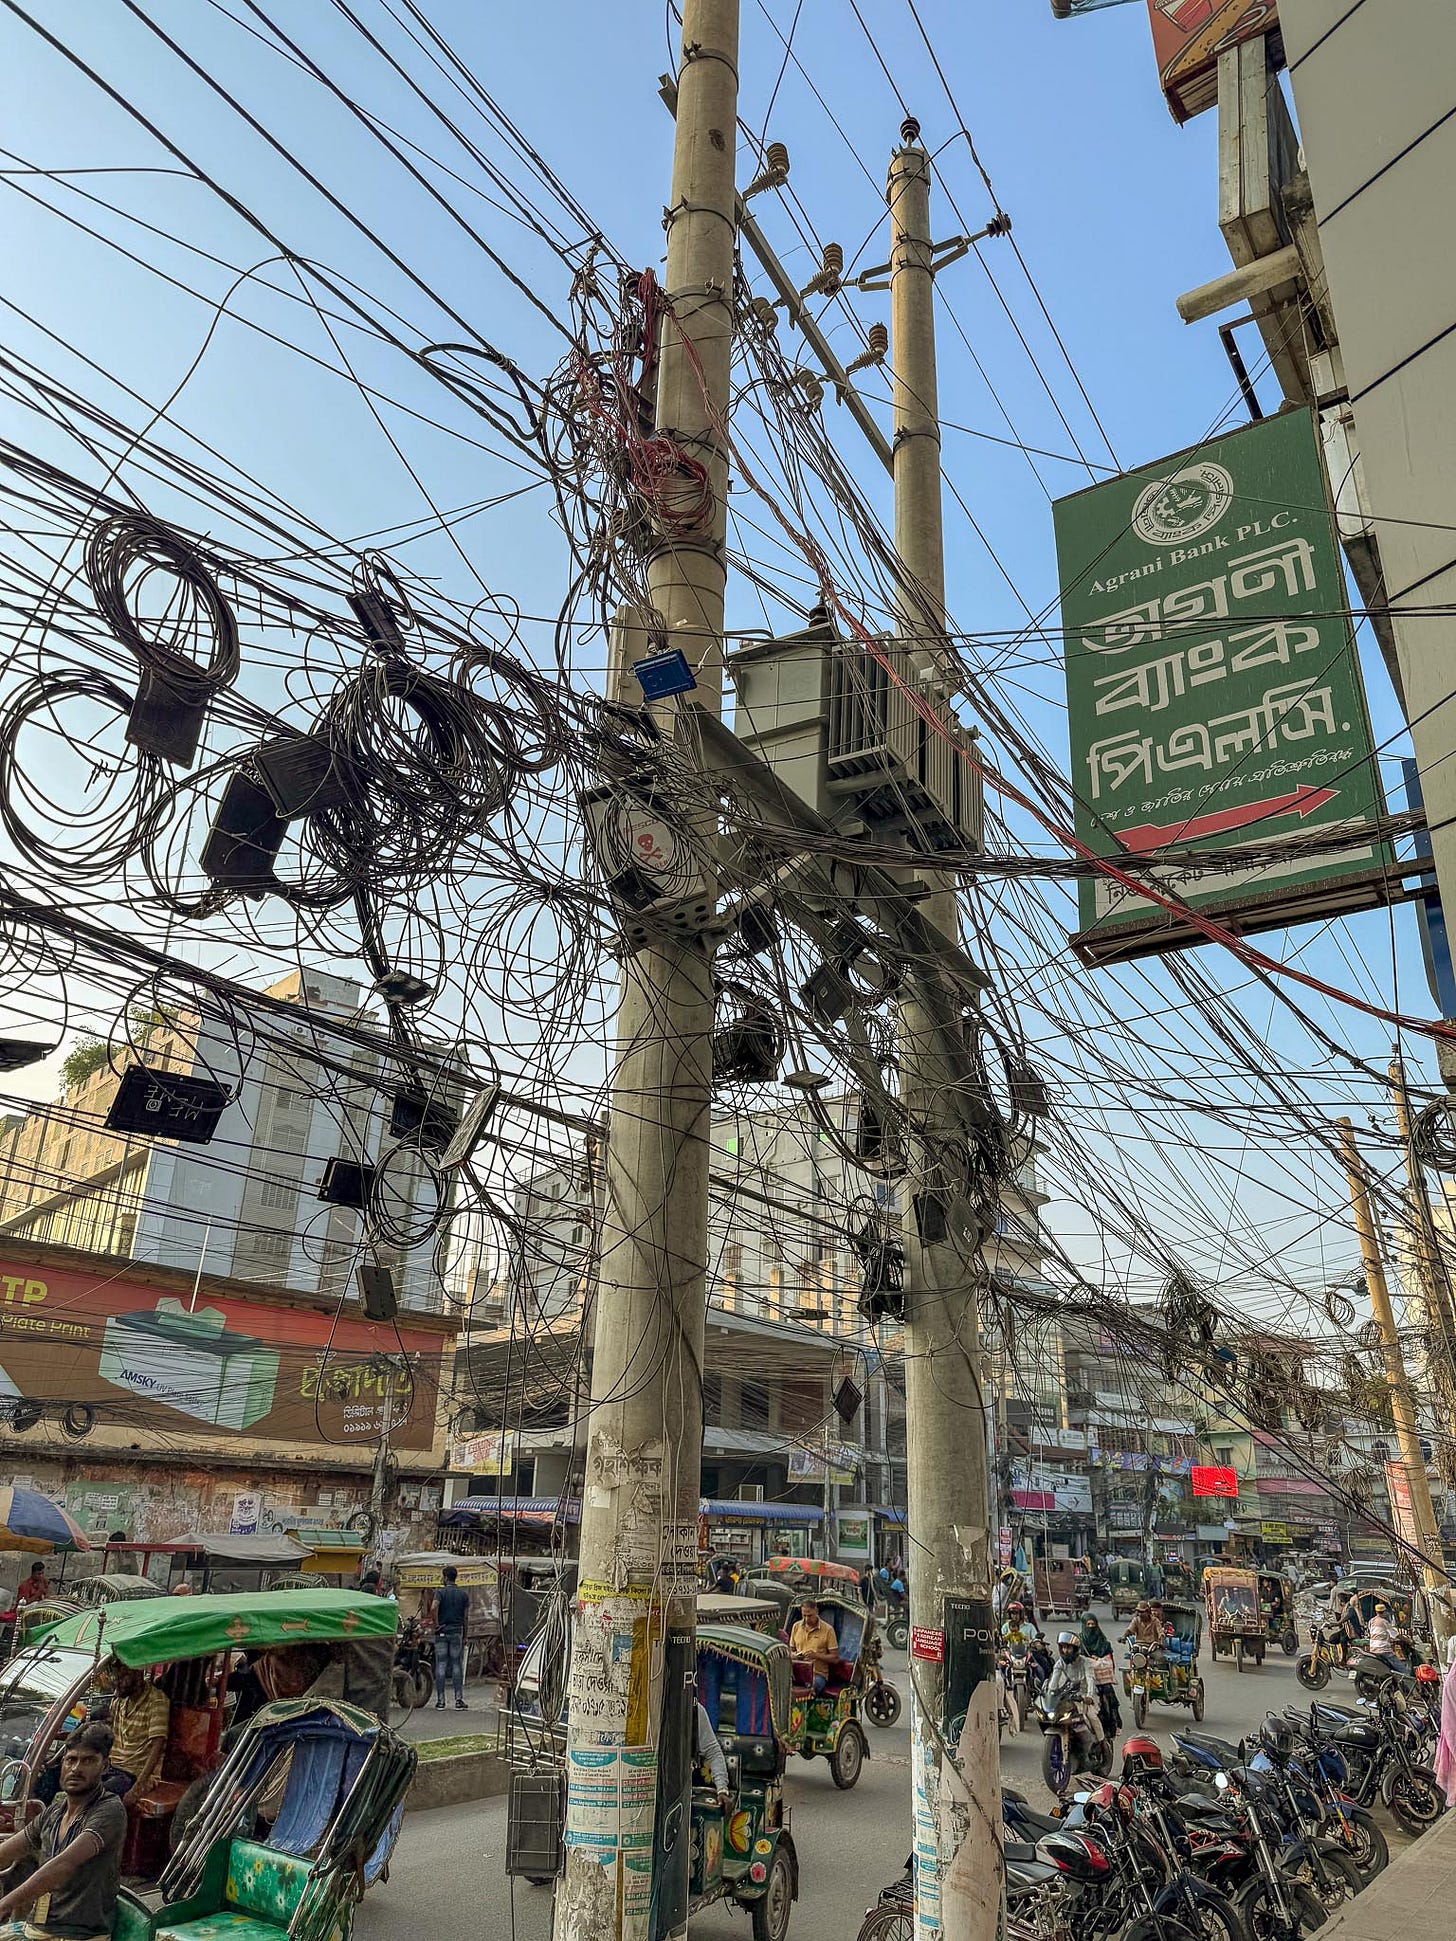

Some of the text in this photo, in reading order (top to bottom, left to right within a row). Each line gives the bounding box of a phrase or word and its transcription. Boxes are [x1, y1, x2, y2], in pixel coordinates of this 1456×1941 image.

[1080, 537, 1315, 655] অগ্রণী
[1089, 511, 1298, 596] Agrani Bank PLC.
[1094, 611, 1320, 716] ব্যাংক
[1086, 676, 1351, 799] পিএলসি.
[120, 1369, 157, 1389] AMSKY
